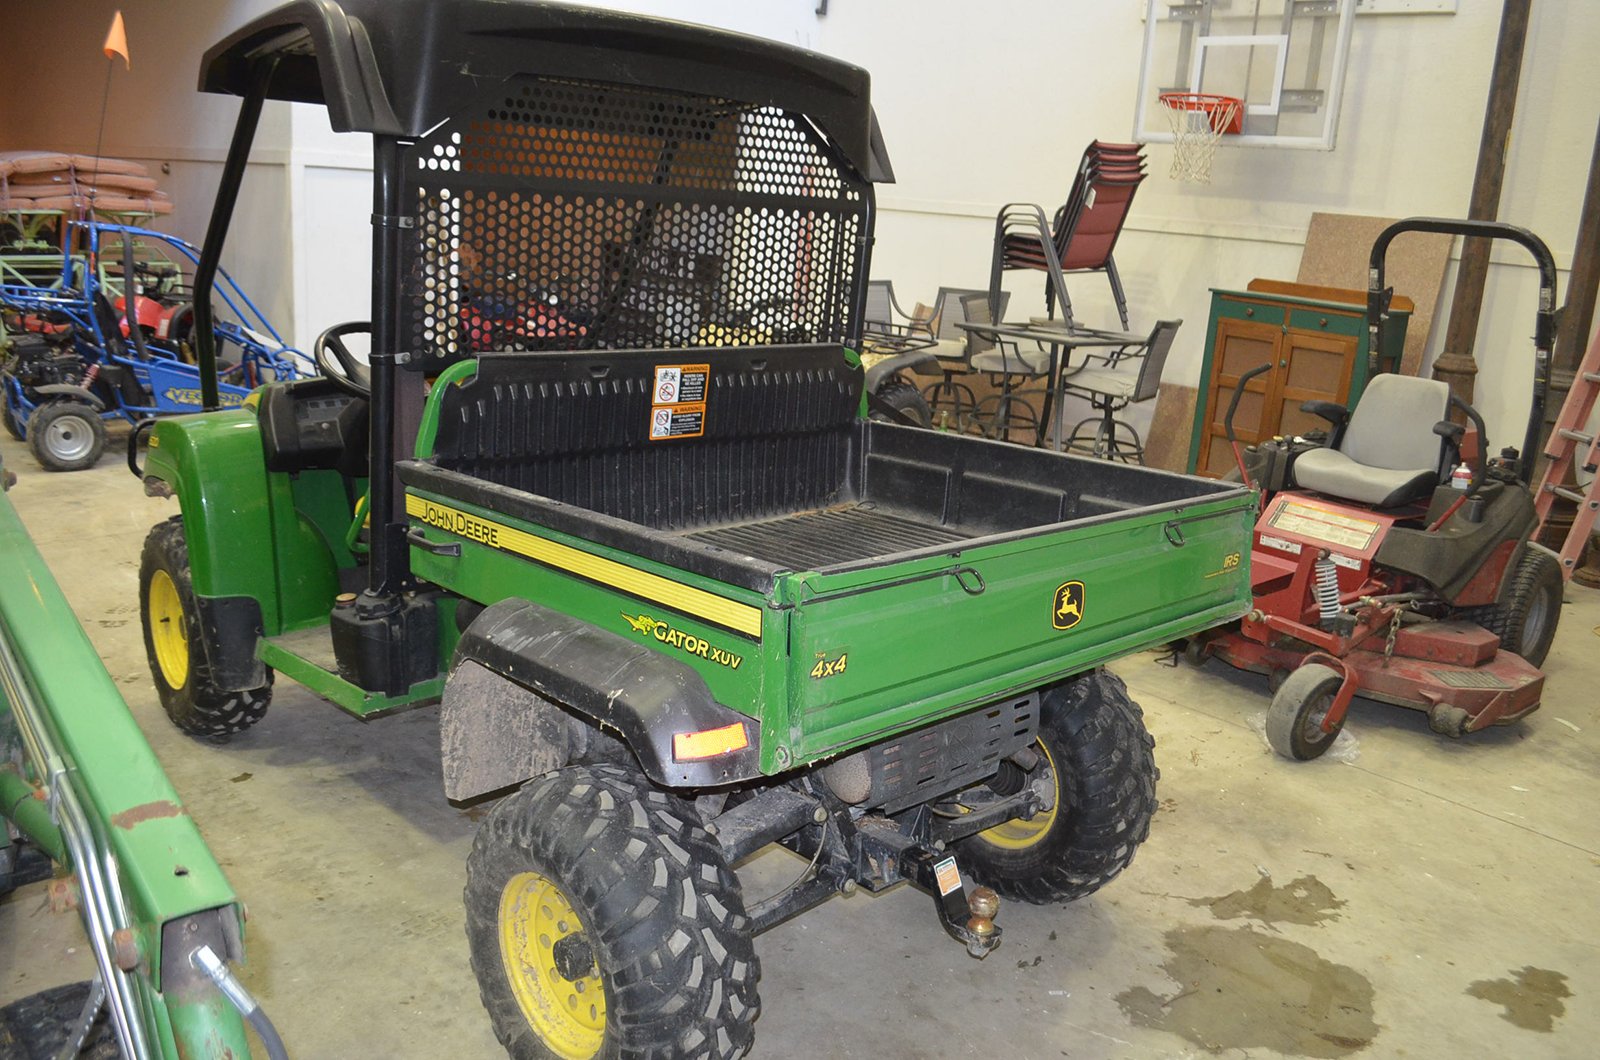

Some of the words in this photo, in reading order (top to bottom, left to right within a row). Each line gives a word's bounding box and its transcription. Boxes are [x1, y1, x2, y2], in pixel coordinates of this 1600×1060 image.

[421, 502, 454, 530] JOHN
[456, 512, 499, 545] DEERE
[1223, 552, 1240, 568] IRS
[653, 620, 711, 660] GATOR
[710, 646, 743, 669] XUV
[810, 653, 848, 679] 4x4
